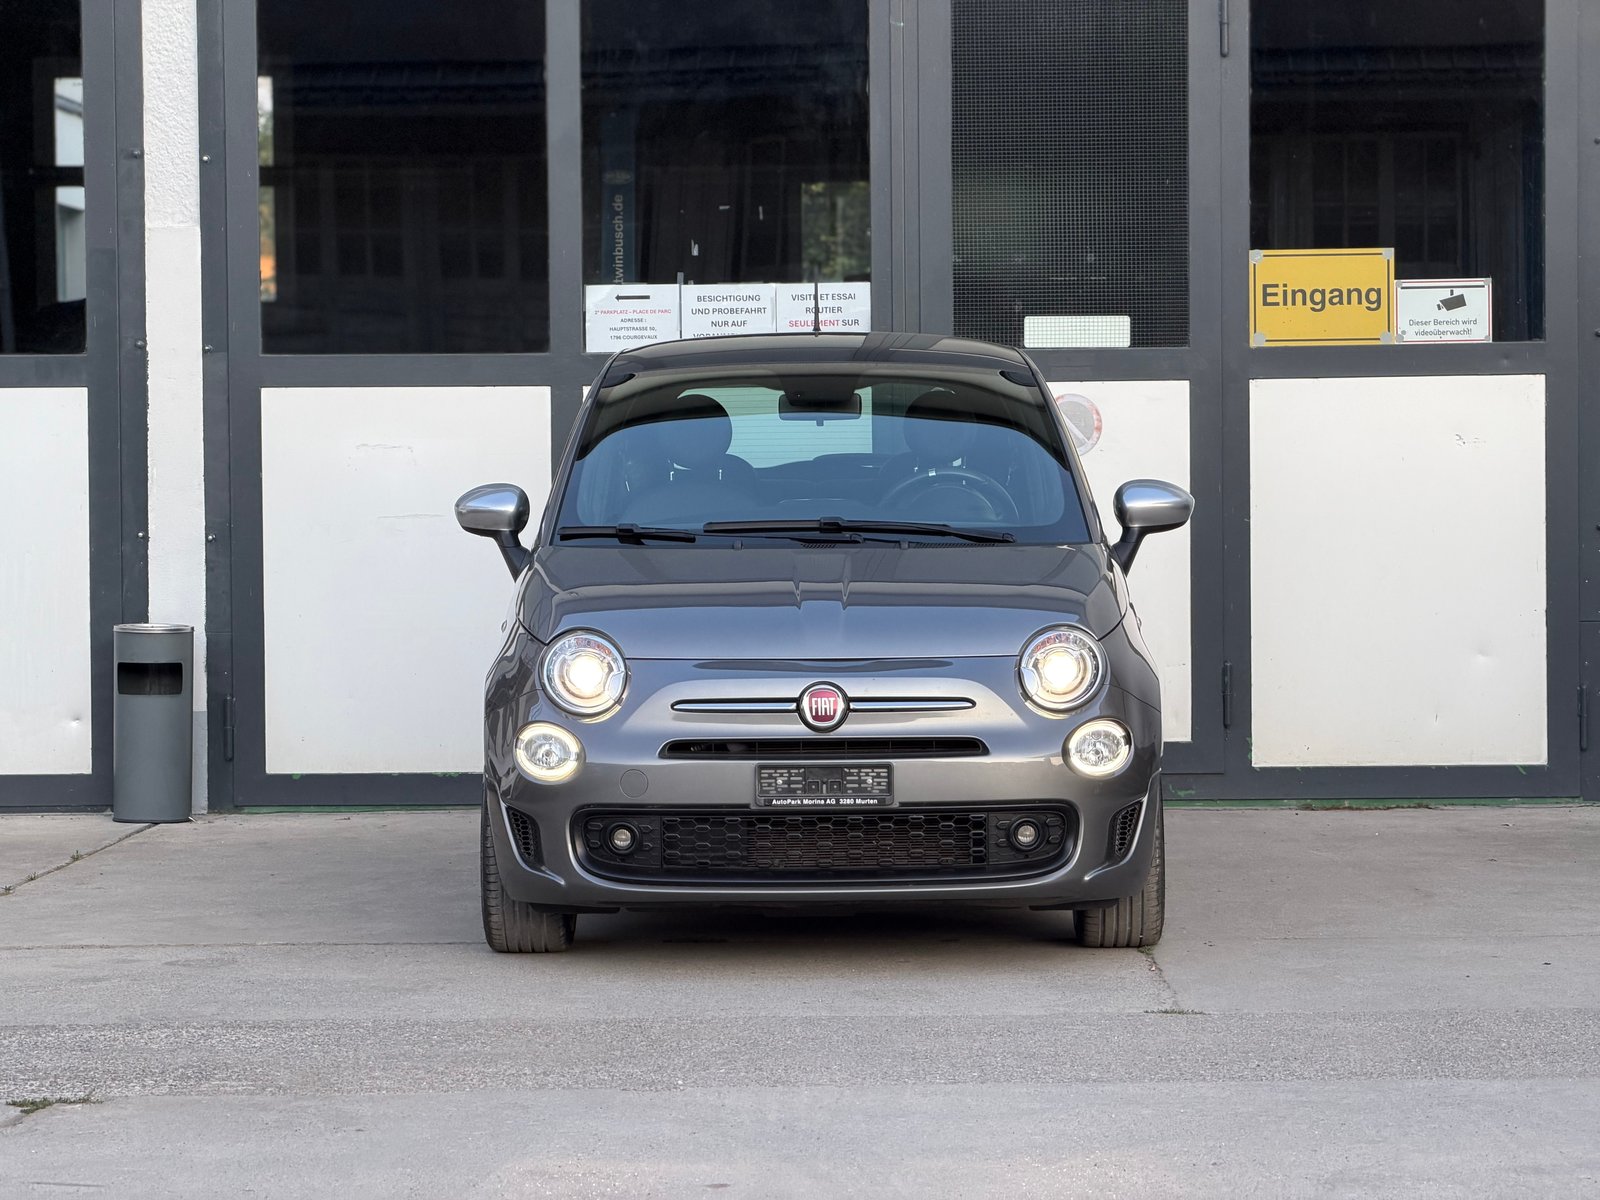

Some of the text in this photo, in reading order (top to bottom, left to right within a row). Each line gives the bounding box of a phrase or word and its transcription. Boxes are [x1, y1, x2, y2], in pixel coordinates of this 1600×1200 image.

[831, 293, 856, 301] ESSAI
[1262, 283, 1382, 312] Eingang
[691, 307, 767, 316] UND PROBEFAHRT
[805, 306, 843, 314] ROUTIER
[711, 320, 747, 328] NUR AUF
[841, 319, 860, 327] SUR
[1433, 318, 1460, 326] Bereich
[1461, 317, 1478, 326] wird
[1414, 327, 1472, 336] videoüberwacht!
[812, 697, 836, 716] FIAT
